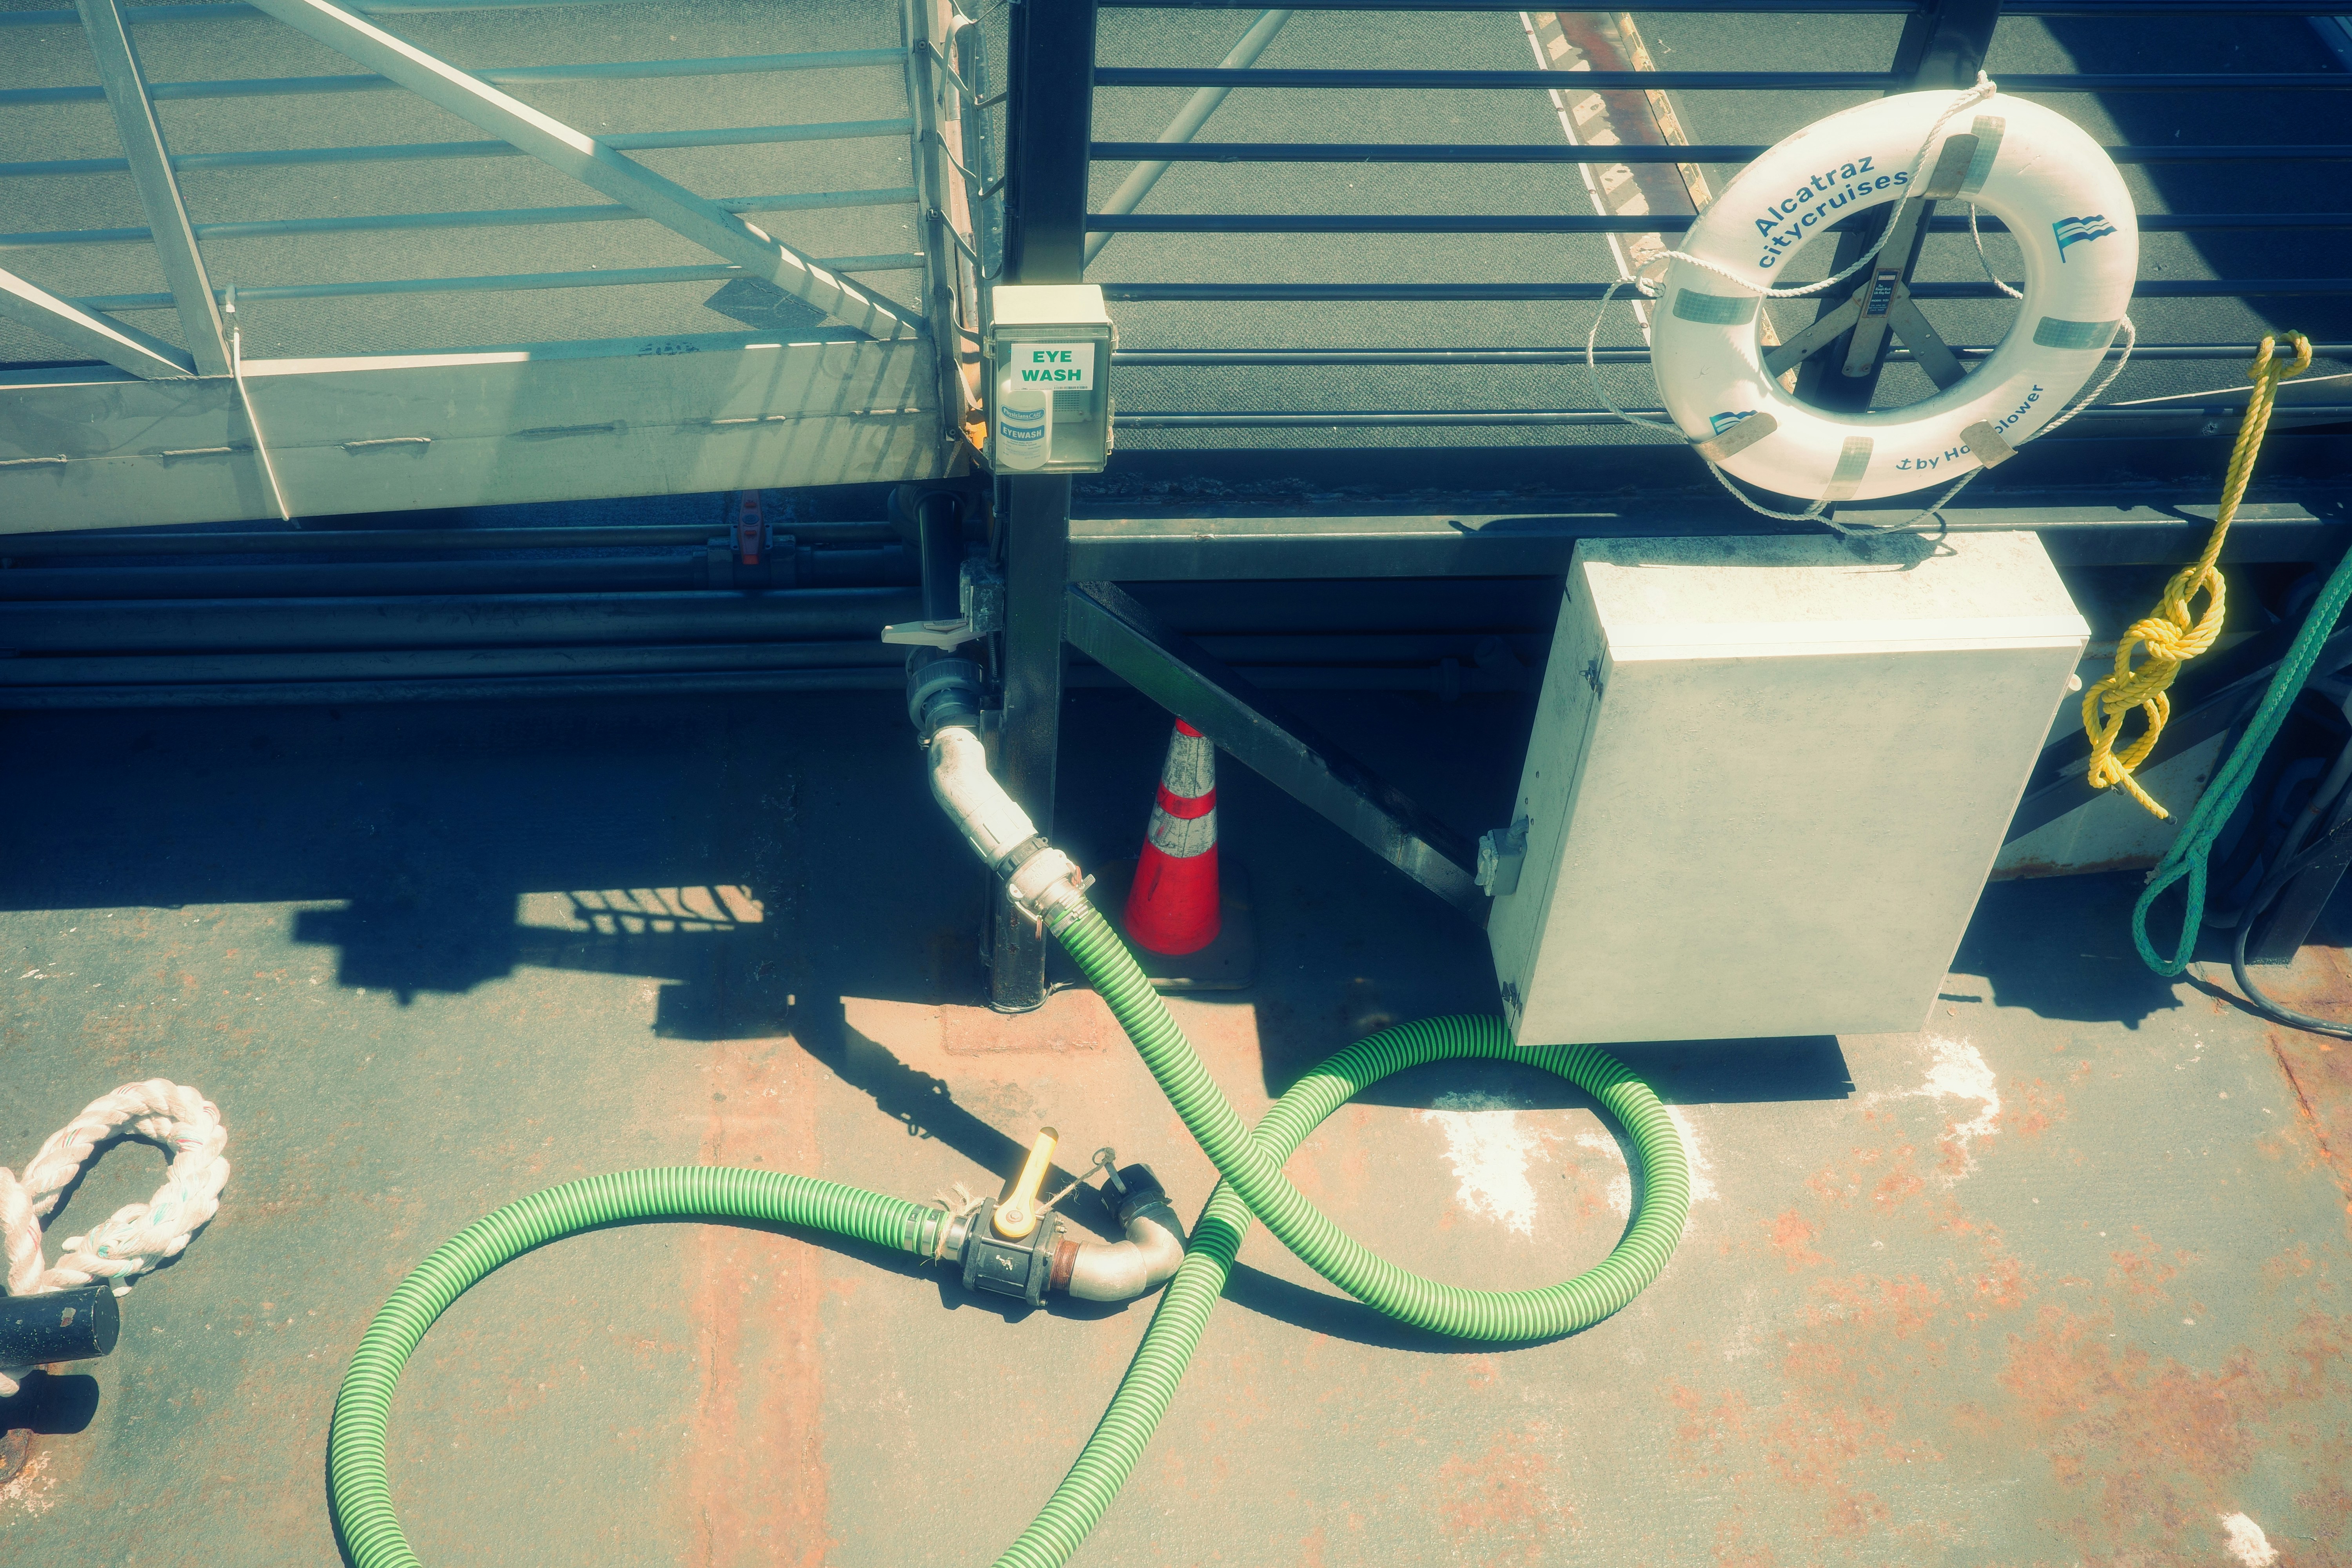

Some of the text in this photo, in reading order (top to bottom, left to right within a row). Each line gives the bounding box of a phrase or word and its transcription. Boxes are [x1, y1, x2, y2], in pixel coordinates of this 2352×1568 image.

[1755, 156, 1875, 238] Alcatraz
[1759, 171, 1909, 269] citycruises
[1033, 350, 1072, 363] EYE
[1022, 369, 1082, 381] WASH
[1003, 426, 1042, 439] EYEWASH
[1916, 456, 1940, 470] by
